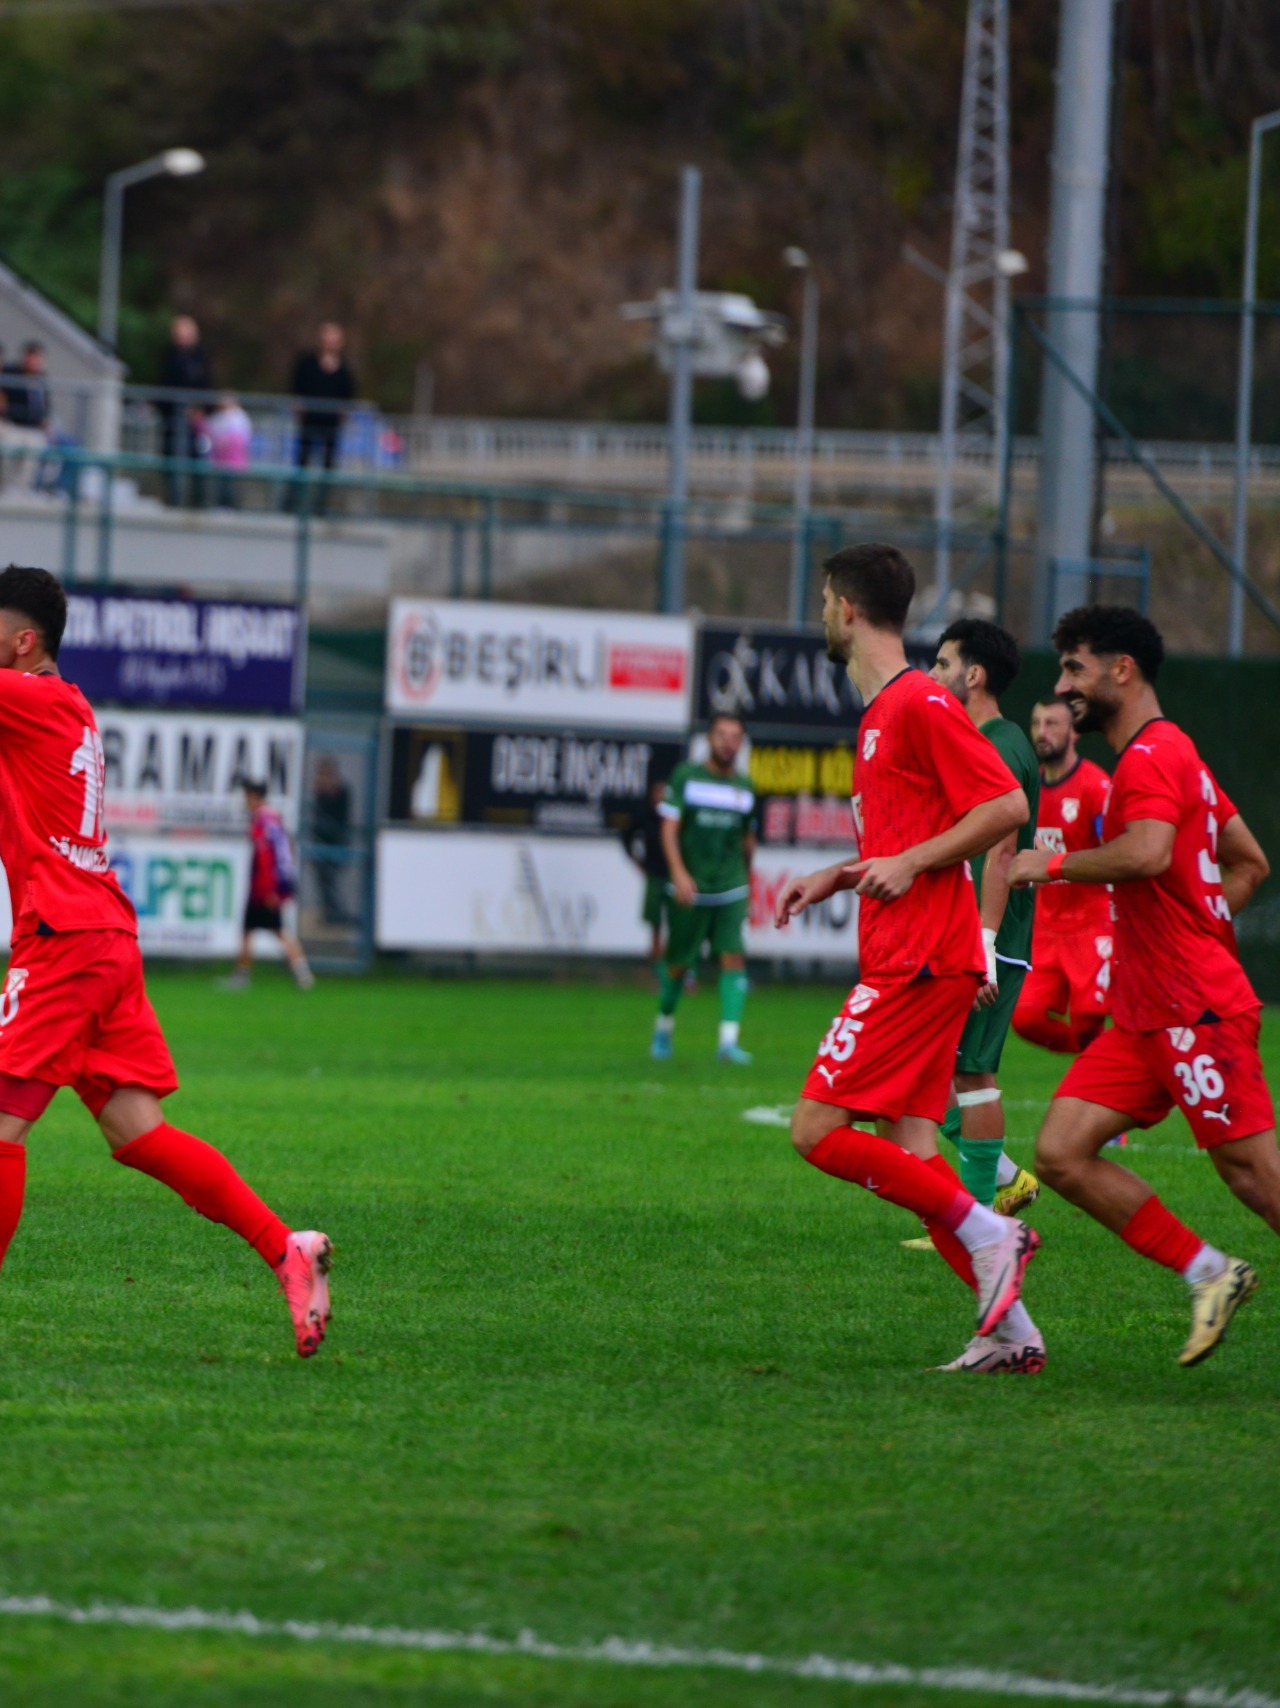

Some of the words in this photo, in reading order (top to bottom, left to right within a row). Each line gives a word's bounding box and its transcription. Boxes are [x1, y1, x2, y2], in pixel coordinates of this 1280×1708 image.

[104, 727, 296, 797] RAMAN
[818, 1017, 864, 1062] 35
[1174, 1054, 1225, 1106] 36
